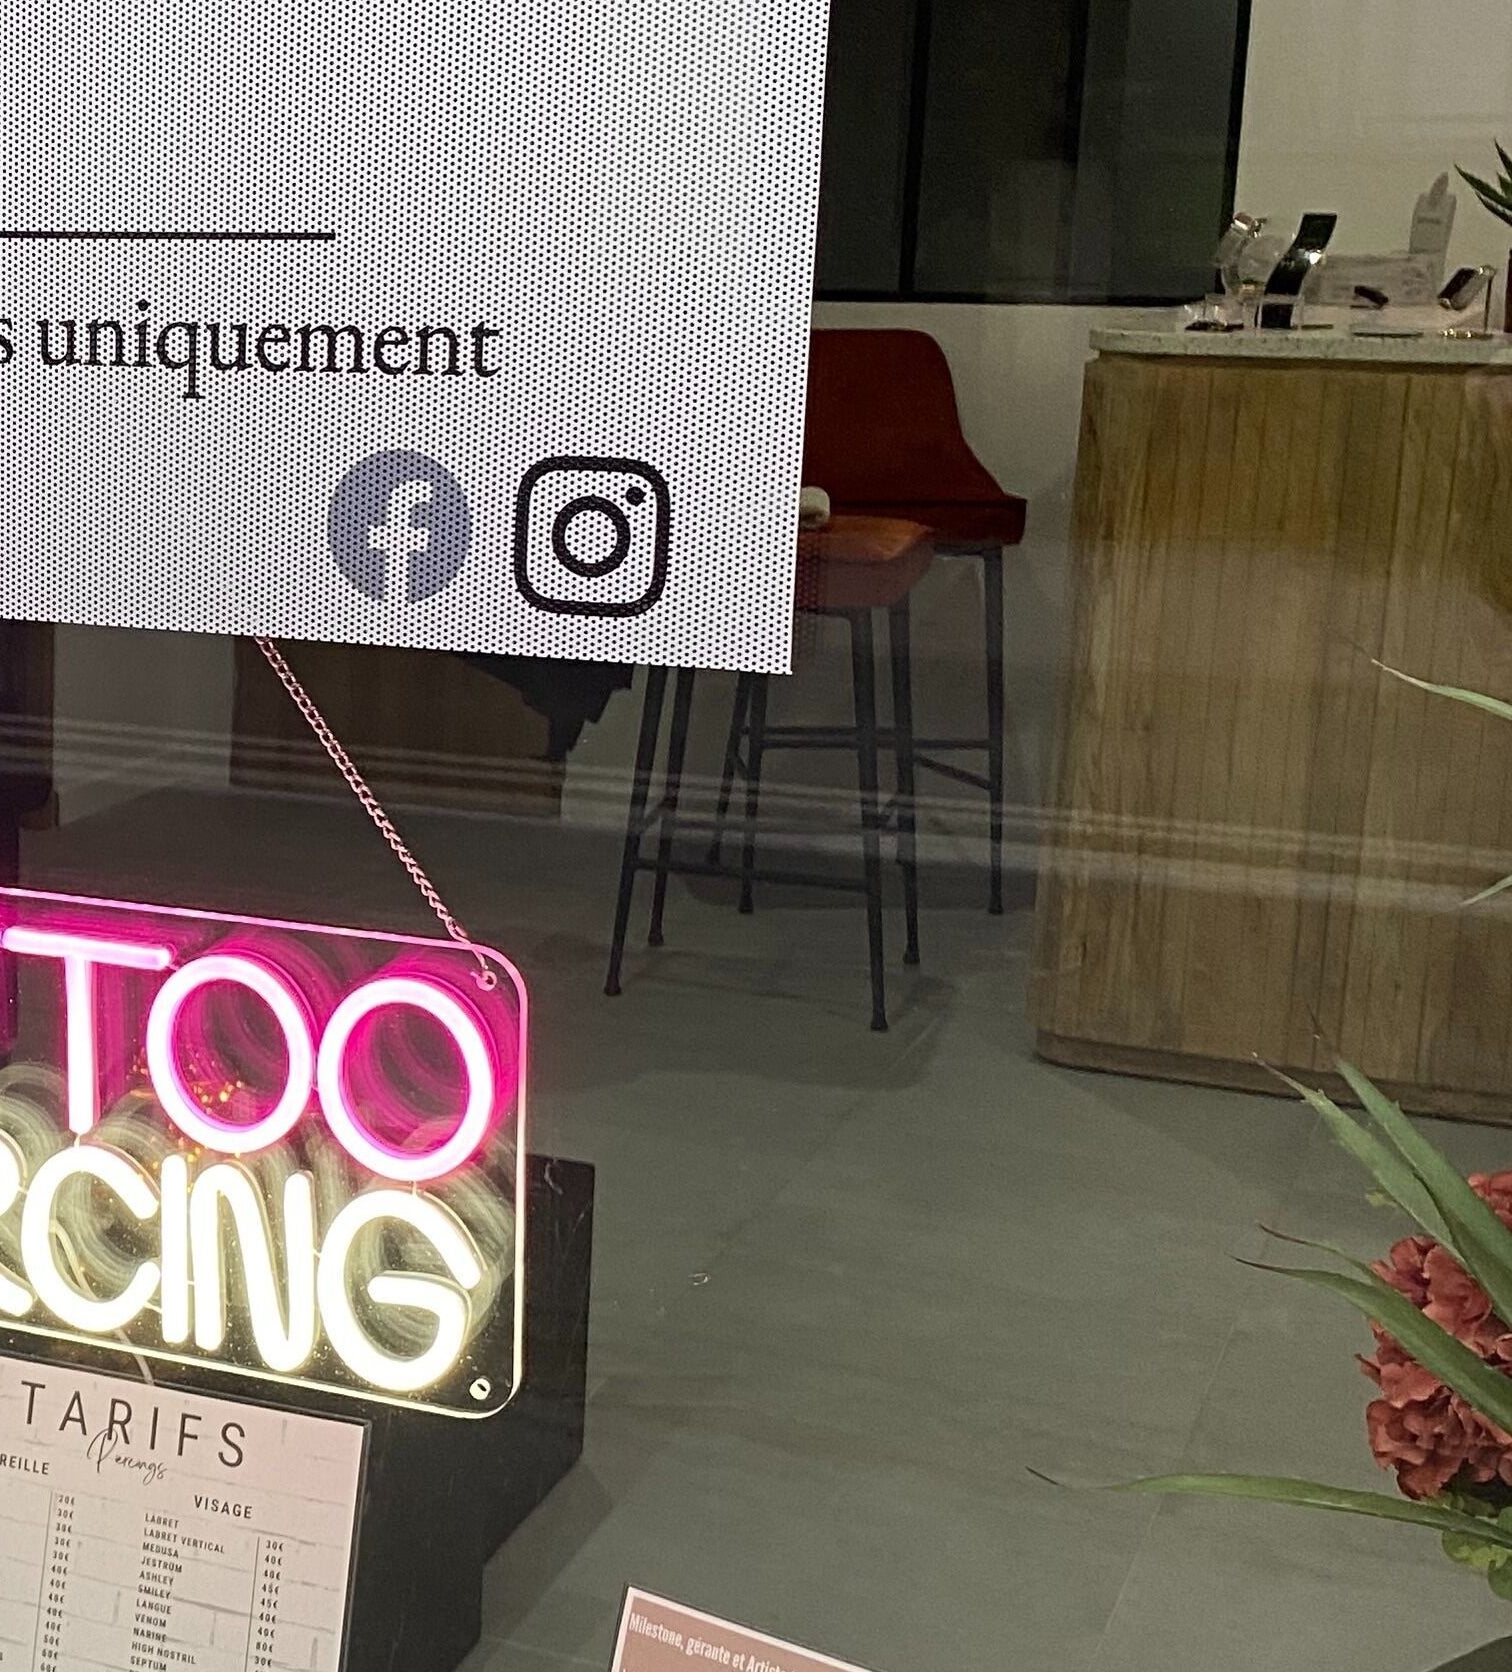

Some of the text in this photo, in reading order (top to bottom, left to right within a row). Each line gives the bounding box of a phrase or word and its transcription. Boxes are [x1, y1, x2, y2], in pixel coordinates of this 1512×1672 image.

[39, 298, 501, 400] uniquement
[21, 1380, 246, 1468] TARIFS
[194, 1494, 254, 1520] VISAGE
[142, 1541, 180, 1558] MEDUSA
[144, 1512, 284, 1552] LABRET 30€
[144, 1527, 283, 1567] LABRET VERTICAL 40€
[141, 1556, 183, 1573] JESTRUM
[137, 1584, 277, 1624] SMILEY 40€
[139, 1569, 278, 1609] ASHLEY 45€
[135, 1613, 167, 1629] VENOM
[136, 1597, 275, 1639] LANGUE 40€
[131, 1641, 197, 1665] HIGH NOSTRIL
[133, 1627, 273, 1668] NARINE 30€
[628, 1613, 685, 1652] Milestone,
[686, 1636, 730, 1665] gérante
[731, 1654, 746, 1671] et
[129, 1655, 167, 1672] SEPTUM
